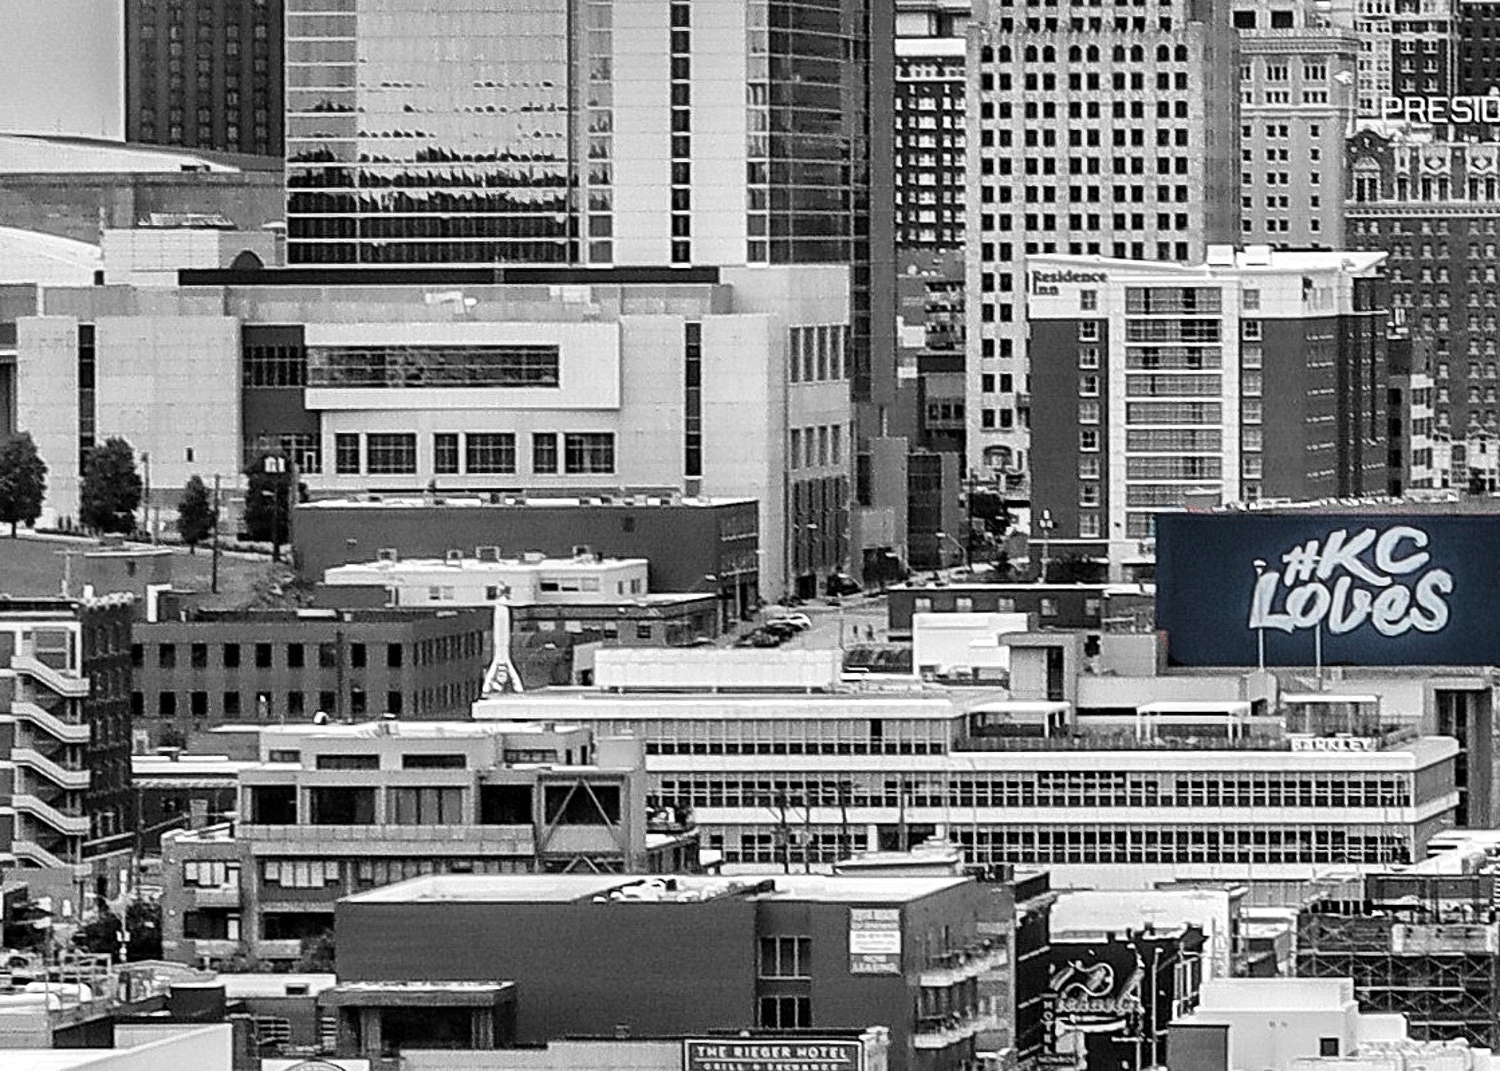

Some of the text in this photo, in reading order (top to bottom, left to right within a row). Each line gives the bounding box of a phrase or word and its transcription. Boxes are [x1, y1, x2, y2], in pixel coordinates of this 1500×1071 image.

[1032, 270, 1107, 283] Residence
[1032, 283, 1059, 296] Inn
[1283, 526, 1430, 587] #KC
[1043, 1001, 1055, 1055] HOTEL
[697, 1046, 846, 1058] THE RIEGER HOTEL
